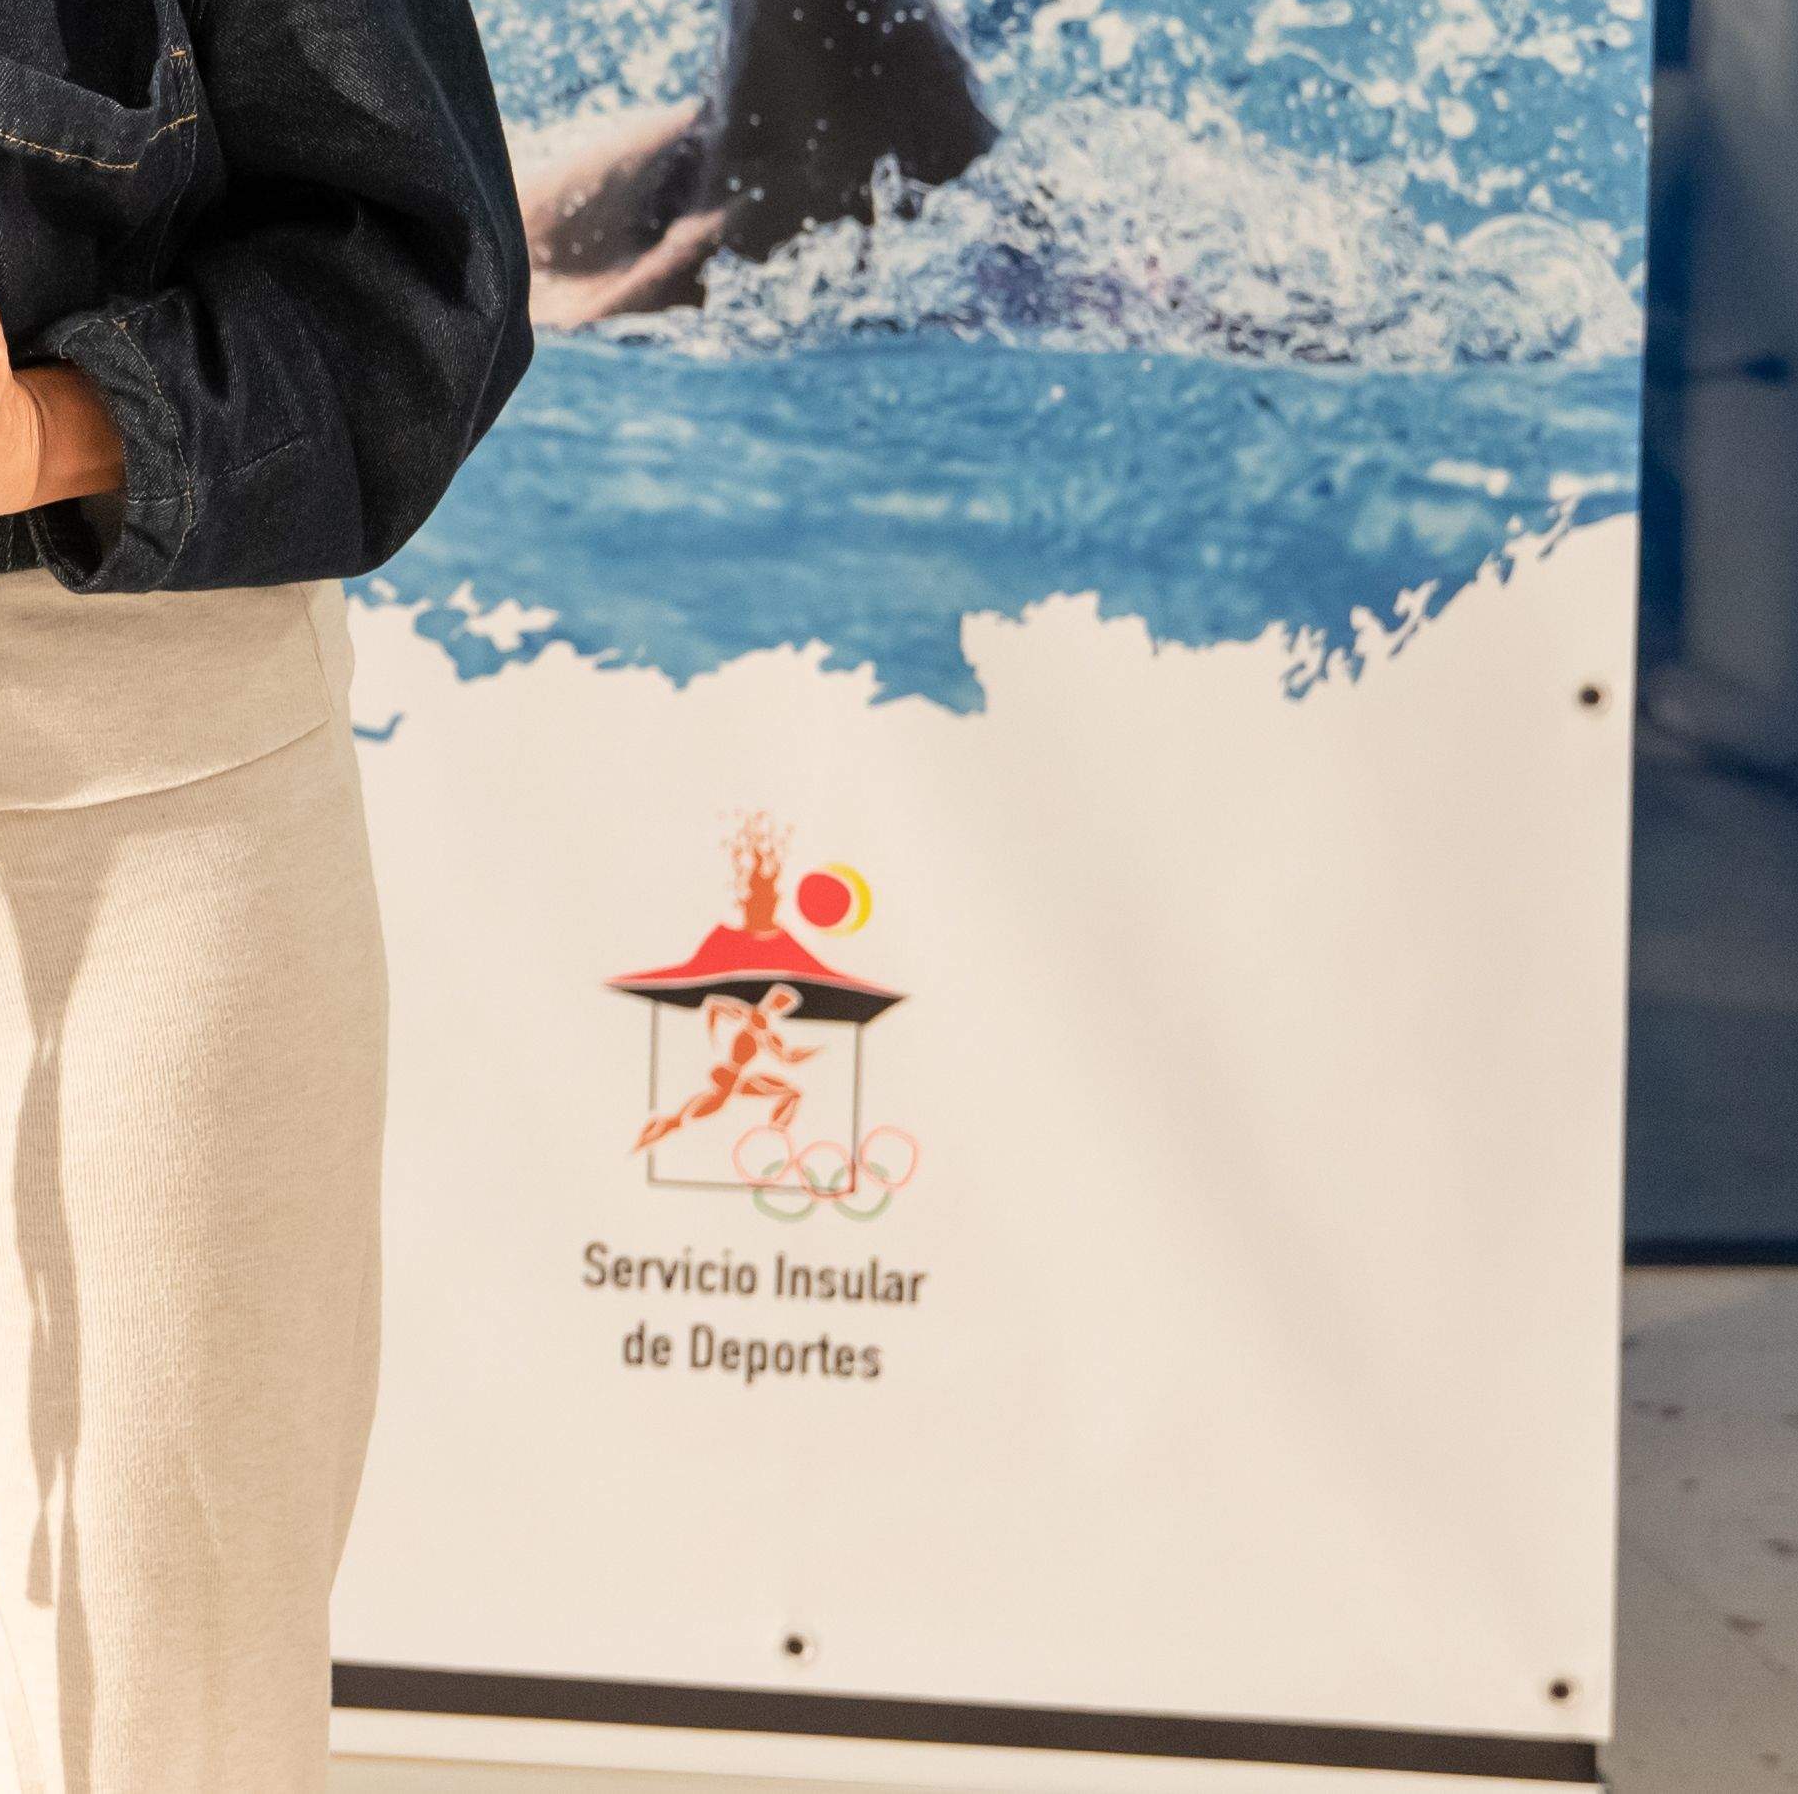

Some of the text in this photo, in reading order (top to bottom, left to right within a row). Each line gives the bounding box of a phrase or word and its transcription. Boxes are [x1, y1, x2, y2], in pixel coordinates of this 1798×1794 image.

[582, 1241, 929, 1305] Servicio Insular
[622, 1321, 882, 1384] de Deportes
